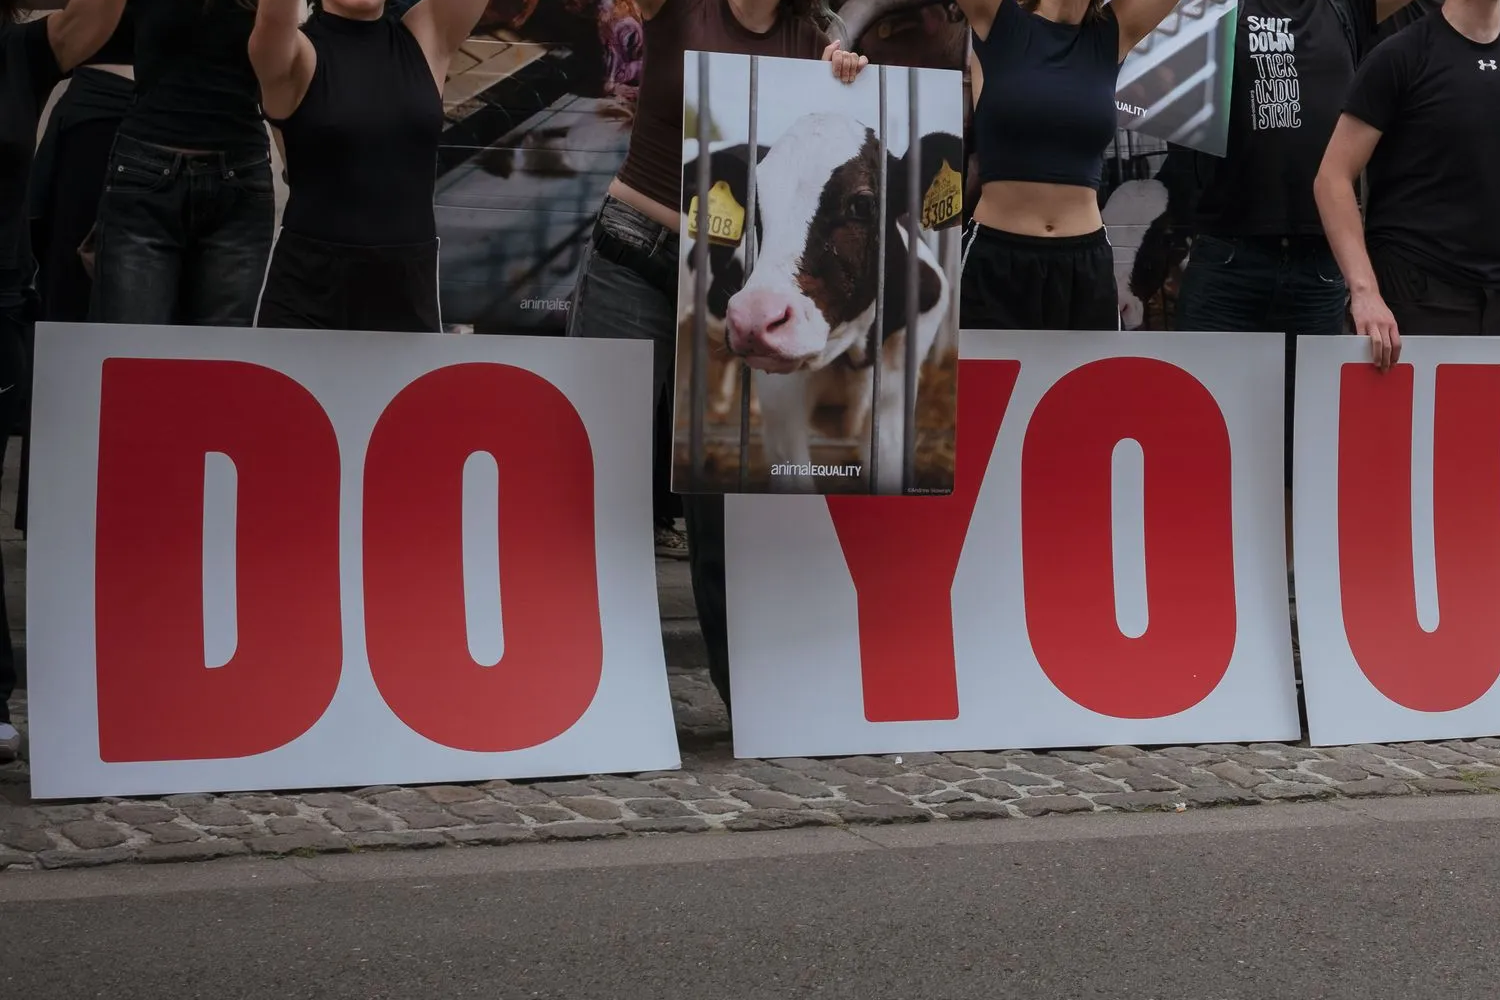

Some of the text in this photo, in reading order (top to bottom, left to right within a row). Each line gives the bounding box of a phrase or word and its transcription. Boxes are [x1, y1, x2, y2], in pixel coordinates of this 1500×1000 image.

[1247, 15, 1292, 33] SHUT
[1248, 31, 1295, 52] DOWN
[691, 210, 733, 236] 308
[922, 195, 953, 228] 3308
[771, 461, 862, 477] animalEQUALITY
[95, 357, 603, 763] DO
